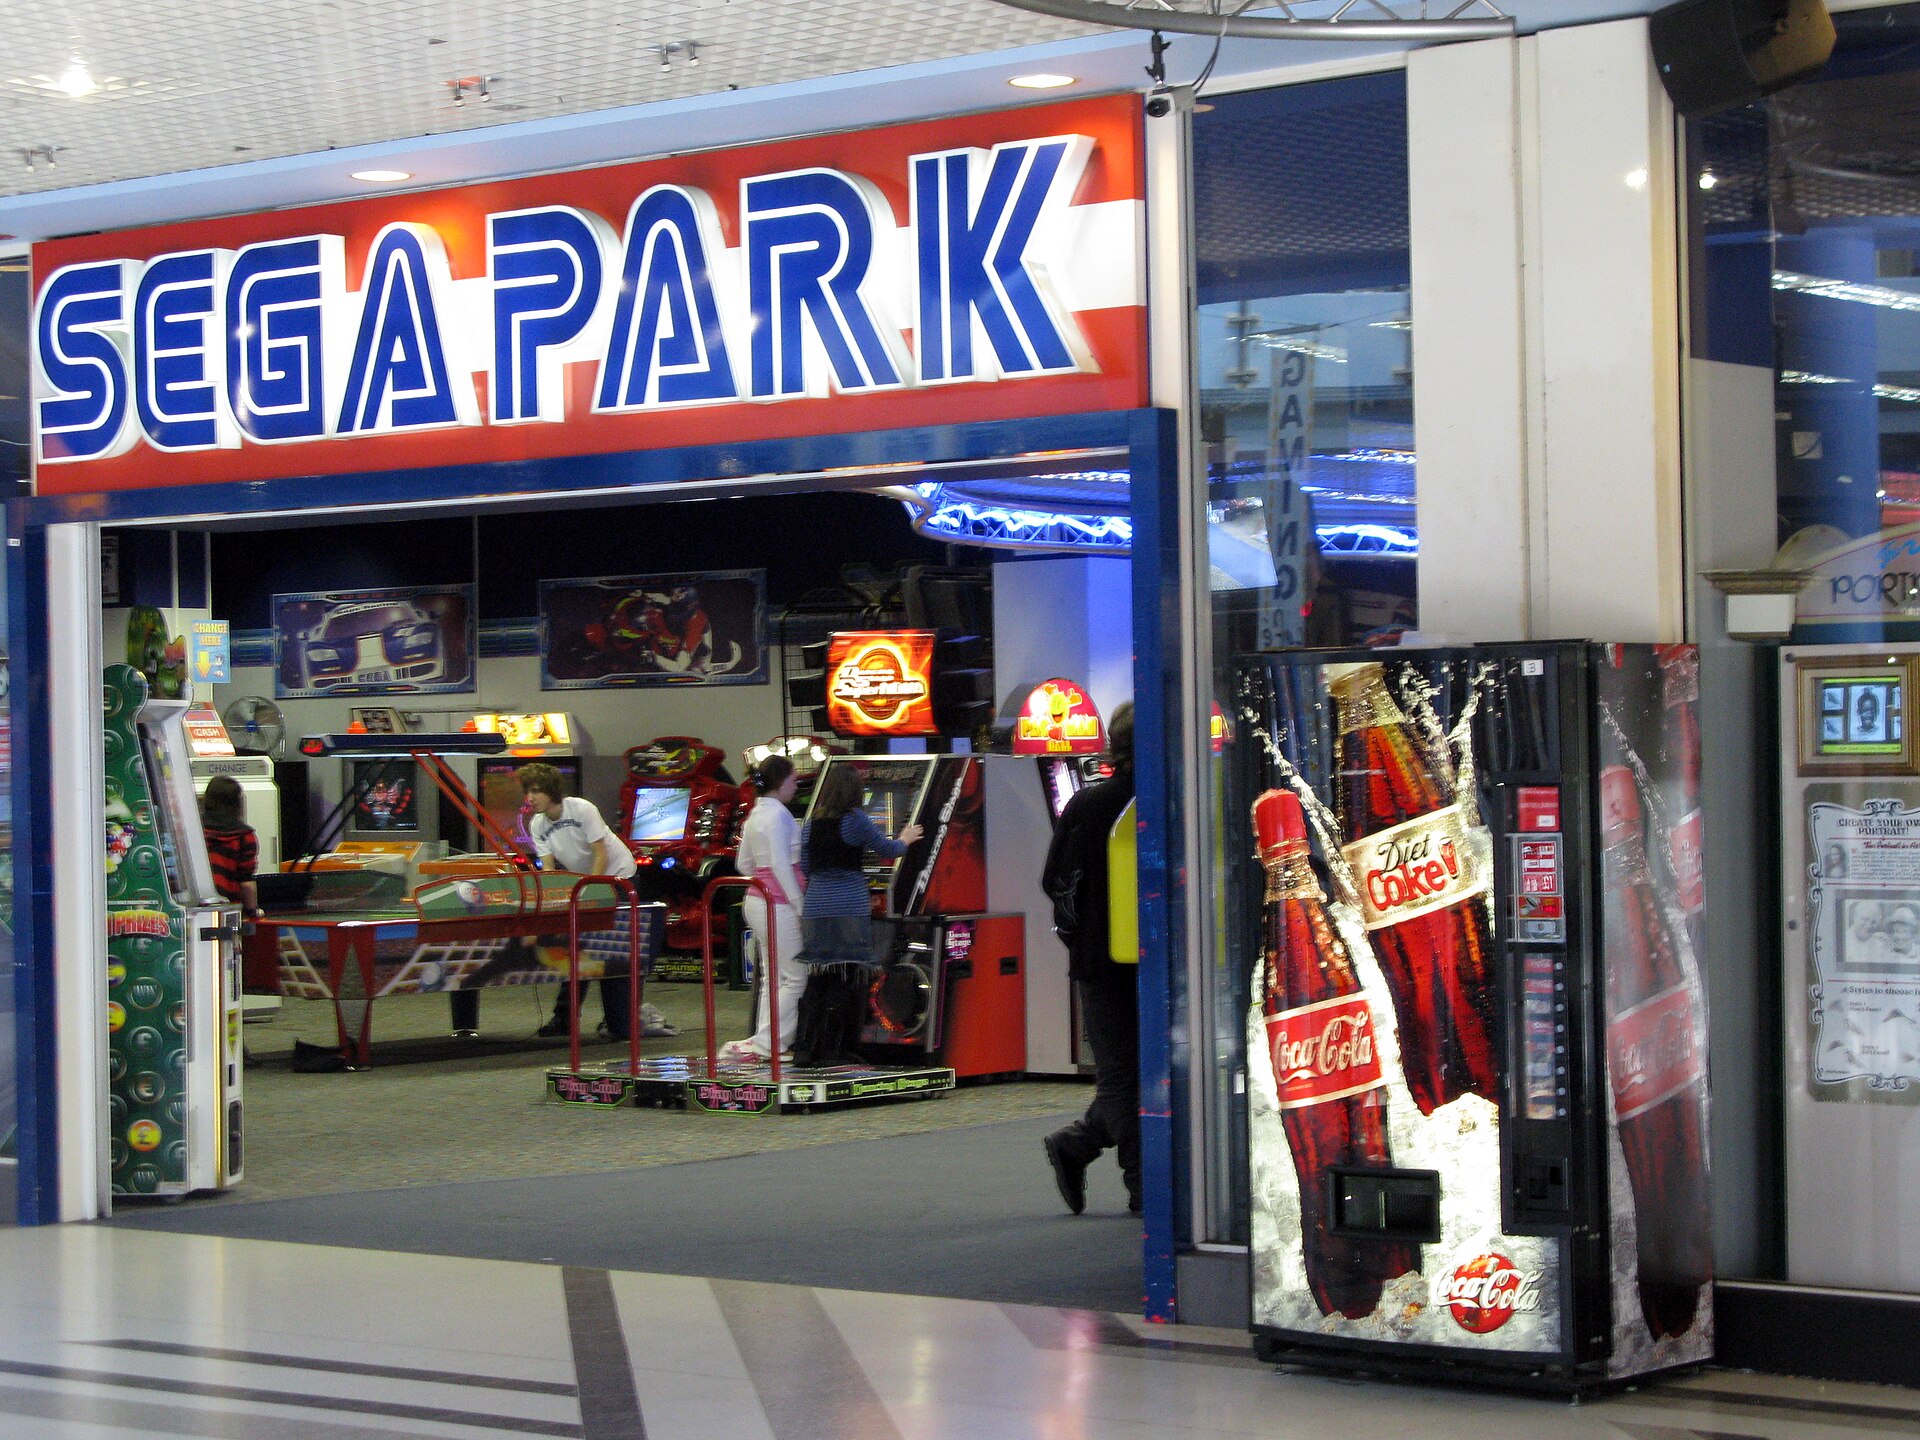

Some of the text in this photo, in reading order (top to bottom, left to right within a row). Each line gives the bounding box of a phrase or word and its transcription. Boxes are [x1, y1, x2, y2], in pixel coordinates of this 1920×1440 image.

[35, 134, 1090, 464] SEGA PARK
[193, 623, 228, 634] CHANGE
[200, 636, 222, 646] HERE
[194, 728, 220, 737] CASH
[208, 763, 248, 774] CHANGE
[1838, 818, 1873, 827] CREATE
[1877, 818, 1902, 827] YOUR
[1378, 833, 1431, 874] Diet
[1367, 860, 1447, 912] Coke
[114, 910, 170, 938] PRIZES
[666, 964, 701, 972] CAUTION
[1273, 1010, 1373, 1084] Coca-Cola
[1431, 1268, 1544, 1312] Coca-Cola
